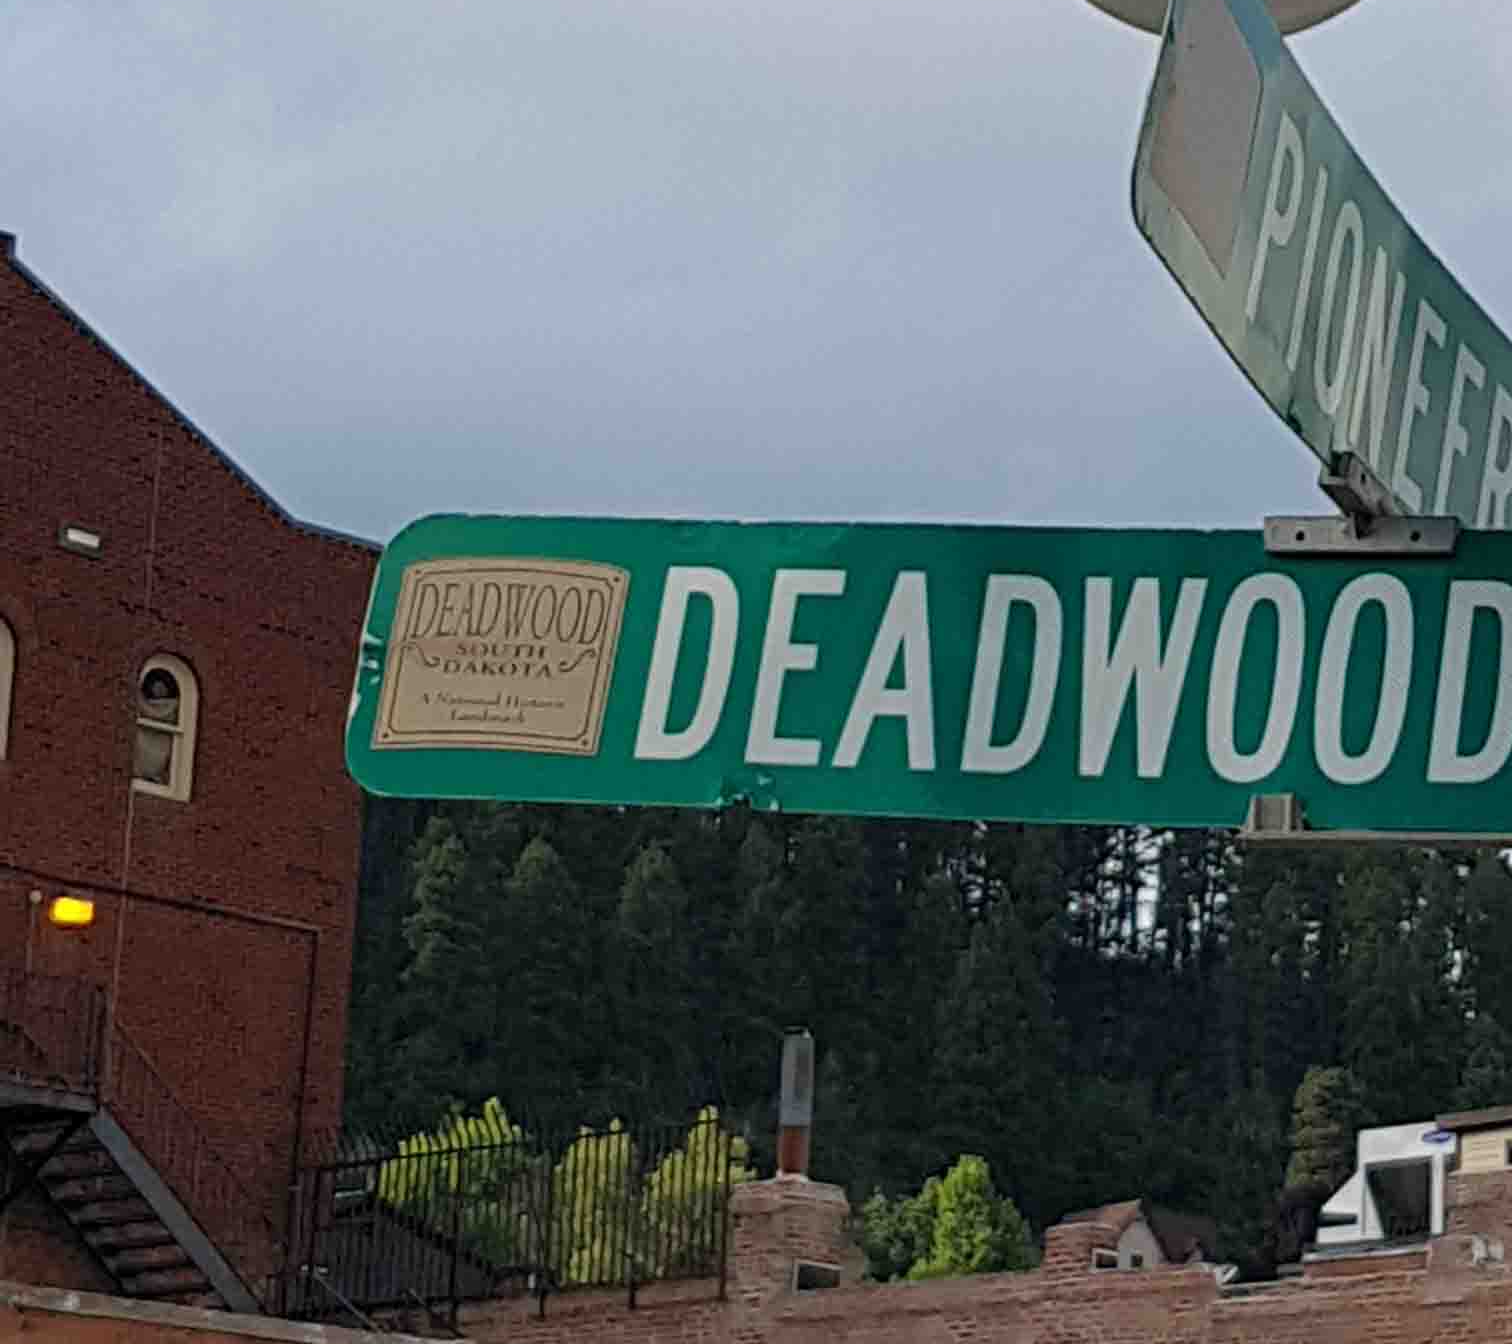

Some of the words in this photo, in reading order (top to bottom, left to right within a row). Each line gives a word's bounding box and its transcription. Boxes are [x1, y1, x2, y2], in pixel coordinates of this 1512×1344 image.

[409, 581, 606, 645] DEADWOOD
[456, 642, 549, 659] SOUTH
[443, 660, 552, 678] DAKOTA
